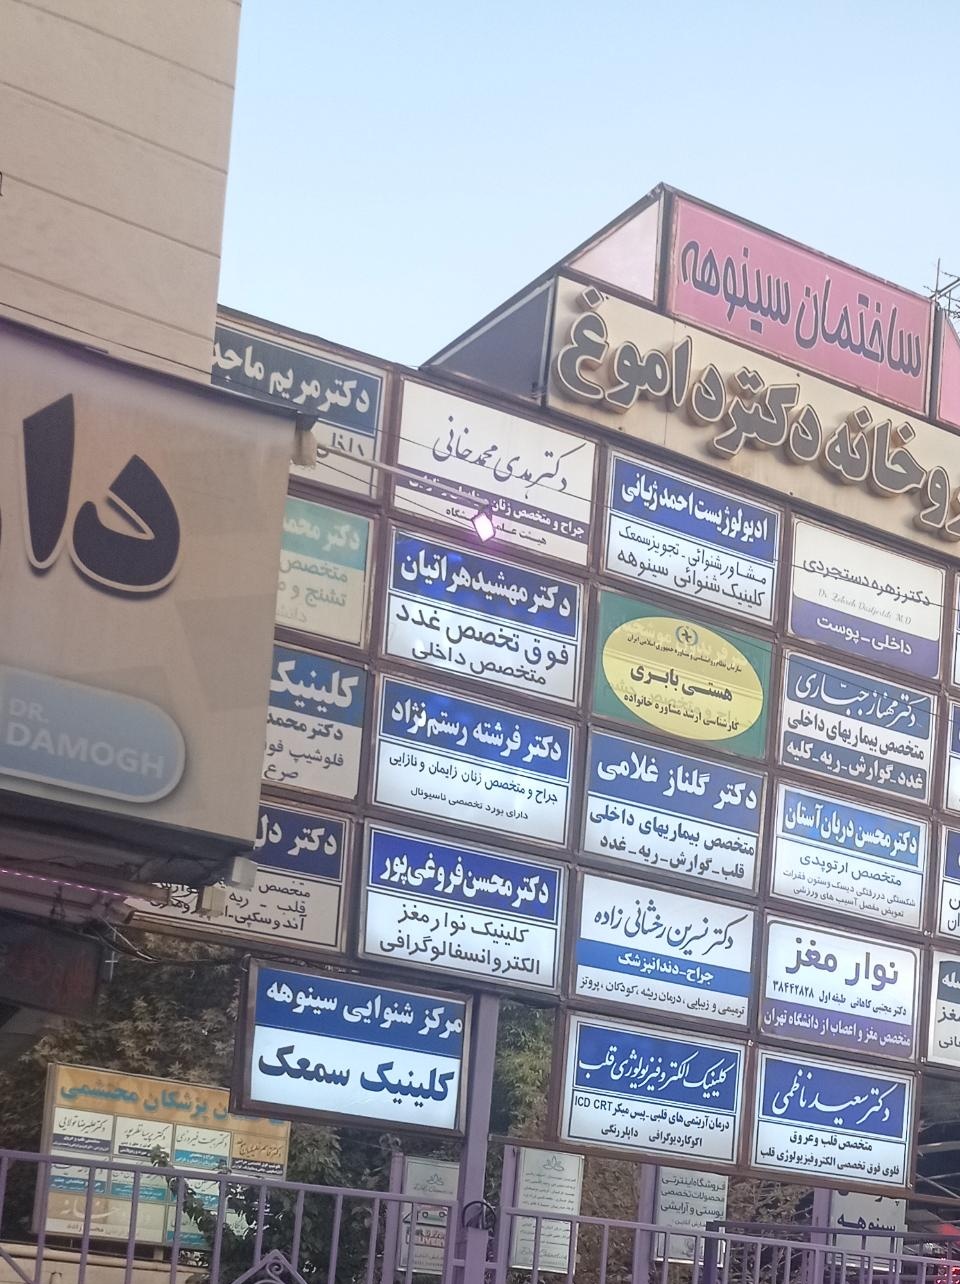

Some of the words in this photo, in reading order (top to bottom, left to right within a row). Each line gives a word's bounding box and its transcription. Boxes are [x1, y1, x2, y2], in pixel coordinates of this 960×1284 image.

[680, 239, 792, 334] سینوهه
[795, 273, 921, 378] ساختمان
[556, 286, 728, 423] داموغ
[270, 368, 320, 404] مریم
[317, 379, 370, 412] دکتر
[712, 367, 824, 460] دکتر
[622, 473, 658, 511] ژیانی
[660, 488, 694, 515] احمد
[491, 498, 511, 515] زنان
[514, 504, 551, 524] متخصص
[552, 519, 558, 530] و
[560, 520, 584, 538] جراح
[694, 500, 768, 542] ادیولوژیست
[279, 559, 347, 583] متخصص
[617, 549, 668, 577] سینوهه
[803, 560, 869, 587] دستجردی
[291, 585, 299, 599] و
[305, 587, 346, 607] تشنج
[472, 571, 528, 605] مهشید
[722, 583, 765, 608] کلینیک
[872, 580, 899, 601] زهره
[902, 590, 930, 606] دکتر
[528, 586, 571, 616] دکتر
[396, 604, 440, 631] غدد
[446, 625, 519, 652] تخصص
[816, 618, 860, 644] پوست
[412, 642, 466, 665] داخلی
[525, 638, 568, 670] فوق
[872, 635, 912, 655] داخلی
[470, 660, 546, 685] متخصص
[630, 664, 679, 691] بابری
[270, 660, 359, 713] کلینیک
[682, 682, 733, 701] هستی
[9, 699, 49, 724] DR.
[624, 694, 652, 707] خانواده
[655, 703, 681, 715] مشاوره
[683, 711, 701, 722] ارشد
[703, 717, 739, 732] کارشناسی
[788, 709, 825, 731] داخلی
[307, 723, 343, 740] دکتر
[826, 720, 878, 751] بیماریهای
[6, 721, 164, 778] DAMOGH
[787, 740, 813, 761] کلیه
[880, 741, 924, 760] متخصص
[597, 752, 659, 783] غلامی
[820, 750, 840, 772] ریه
[849, 756, 893, 783] گوارش
[264, 764, 298, 781] صرع
[663, 765, 710, 797] گلناز
[898, 772, 923, 789] غدد
[410, 787, 446, 801] ناسیونال
[448, 795, 483, 810] تخصصی
[713, 782, 757, 809] دکتر
[485, 804, 504, 816] بورد
[506, 805, 528, 819] دارای
[589, 804, 634, 826] داخلی
[639, 816, 700, 846] بیماریهای
[600, 836, 627, 851] غدد
[704, 836, 755, 856] متخصص
[639, 846, 659, 864] ریه
[670, 851, 712, 875] گوارش
[800, 855, 848, 874] ارتوپدی
[721, 863, 744, 880] قلب
[851, 871, 901, 886] متخصص
[229, 892, 249, 907] ریه
[259, 880, 311, 898] متخصص
[277, 901, 306, 915] قلب
[398, 903, 429, 923] مغز
[430, 912, 466, 936] نوار
[471, 921, 529, 945] کلینیک
[785, 938, 837, 974] مغز
[845, 952, 898, 991] نوار
[267, 982, 338, 1014] سینوهه
[343, 995, 414, 1028] شنوایی
[418, 1007, 463, 1038] مرکز
[764, 1008, 787, 1025] تهران
[789, 1010, 819, 1029] دانشگاه
[820, 1019, 829, 1035] از
[831, 1020, 856, 1036] اعصاب
[857, 1030, 863, 1042] و
[864, 1026, 877, 1043] مغز
[880, 1031, 910, 1046] متخصص
[258, 1045, 349, 1087] سمعک
[579, 1046, 617, 1079] قلب
[360, 1061, 454, 1107] کلینیک
[683, 1058, 735, 1099] کلینیک
[575, 1096, 590, 1107] ICD
[594, 1100, 613, 1111] CRT
[808, 1092, 869, 1125] سعید
[856, 1084, 898, 1124] دکتر
[650, 1109, 667, 1121] قلبی
[709, 1118, 729, 1131] درمان
[661, 1202, 689, 1213] آرایشی
[690, 1207, 694, 1215] و
